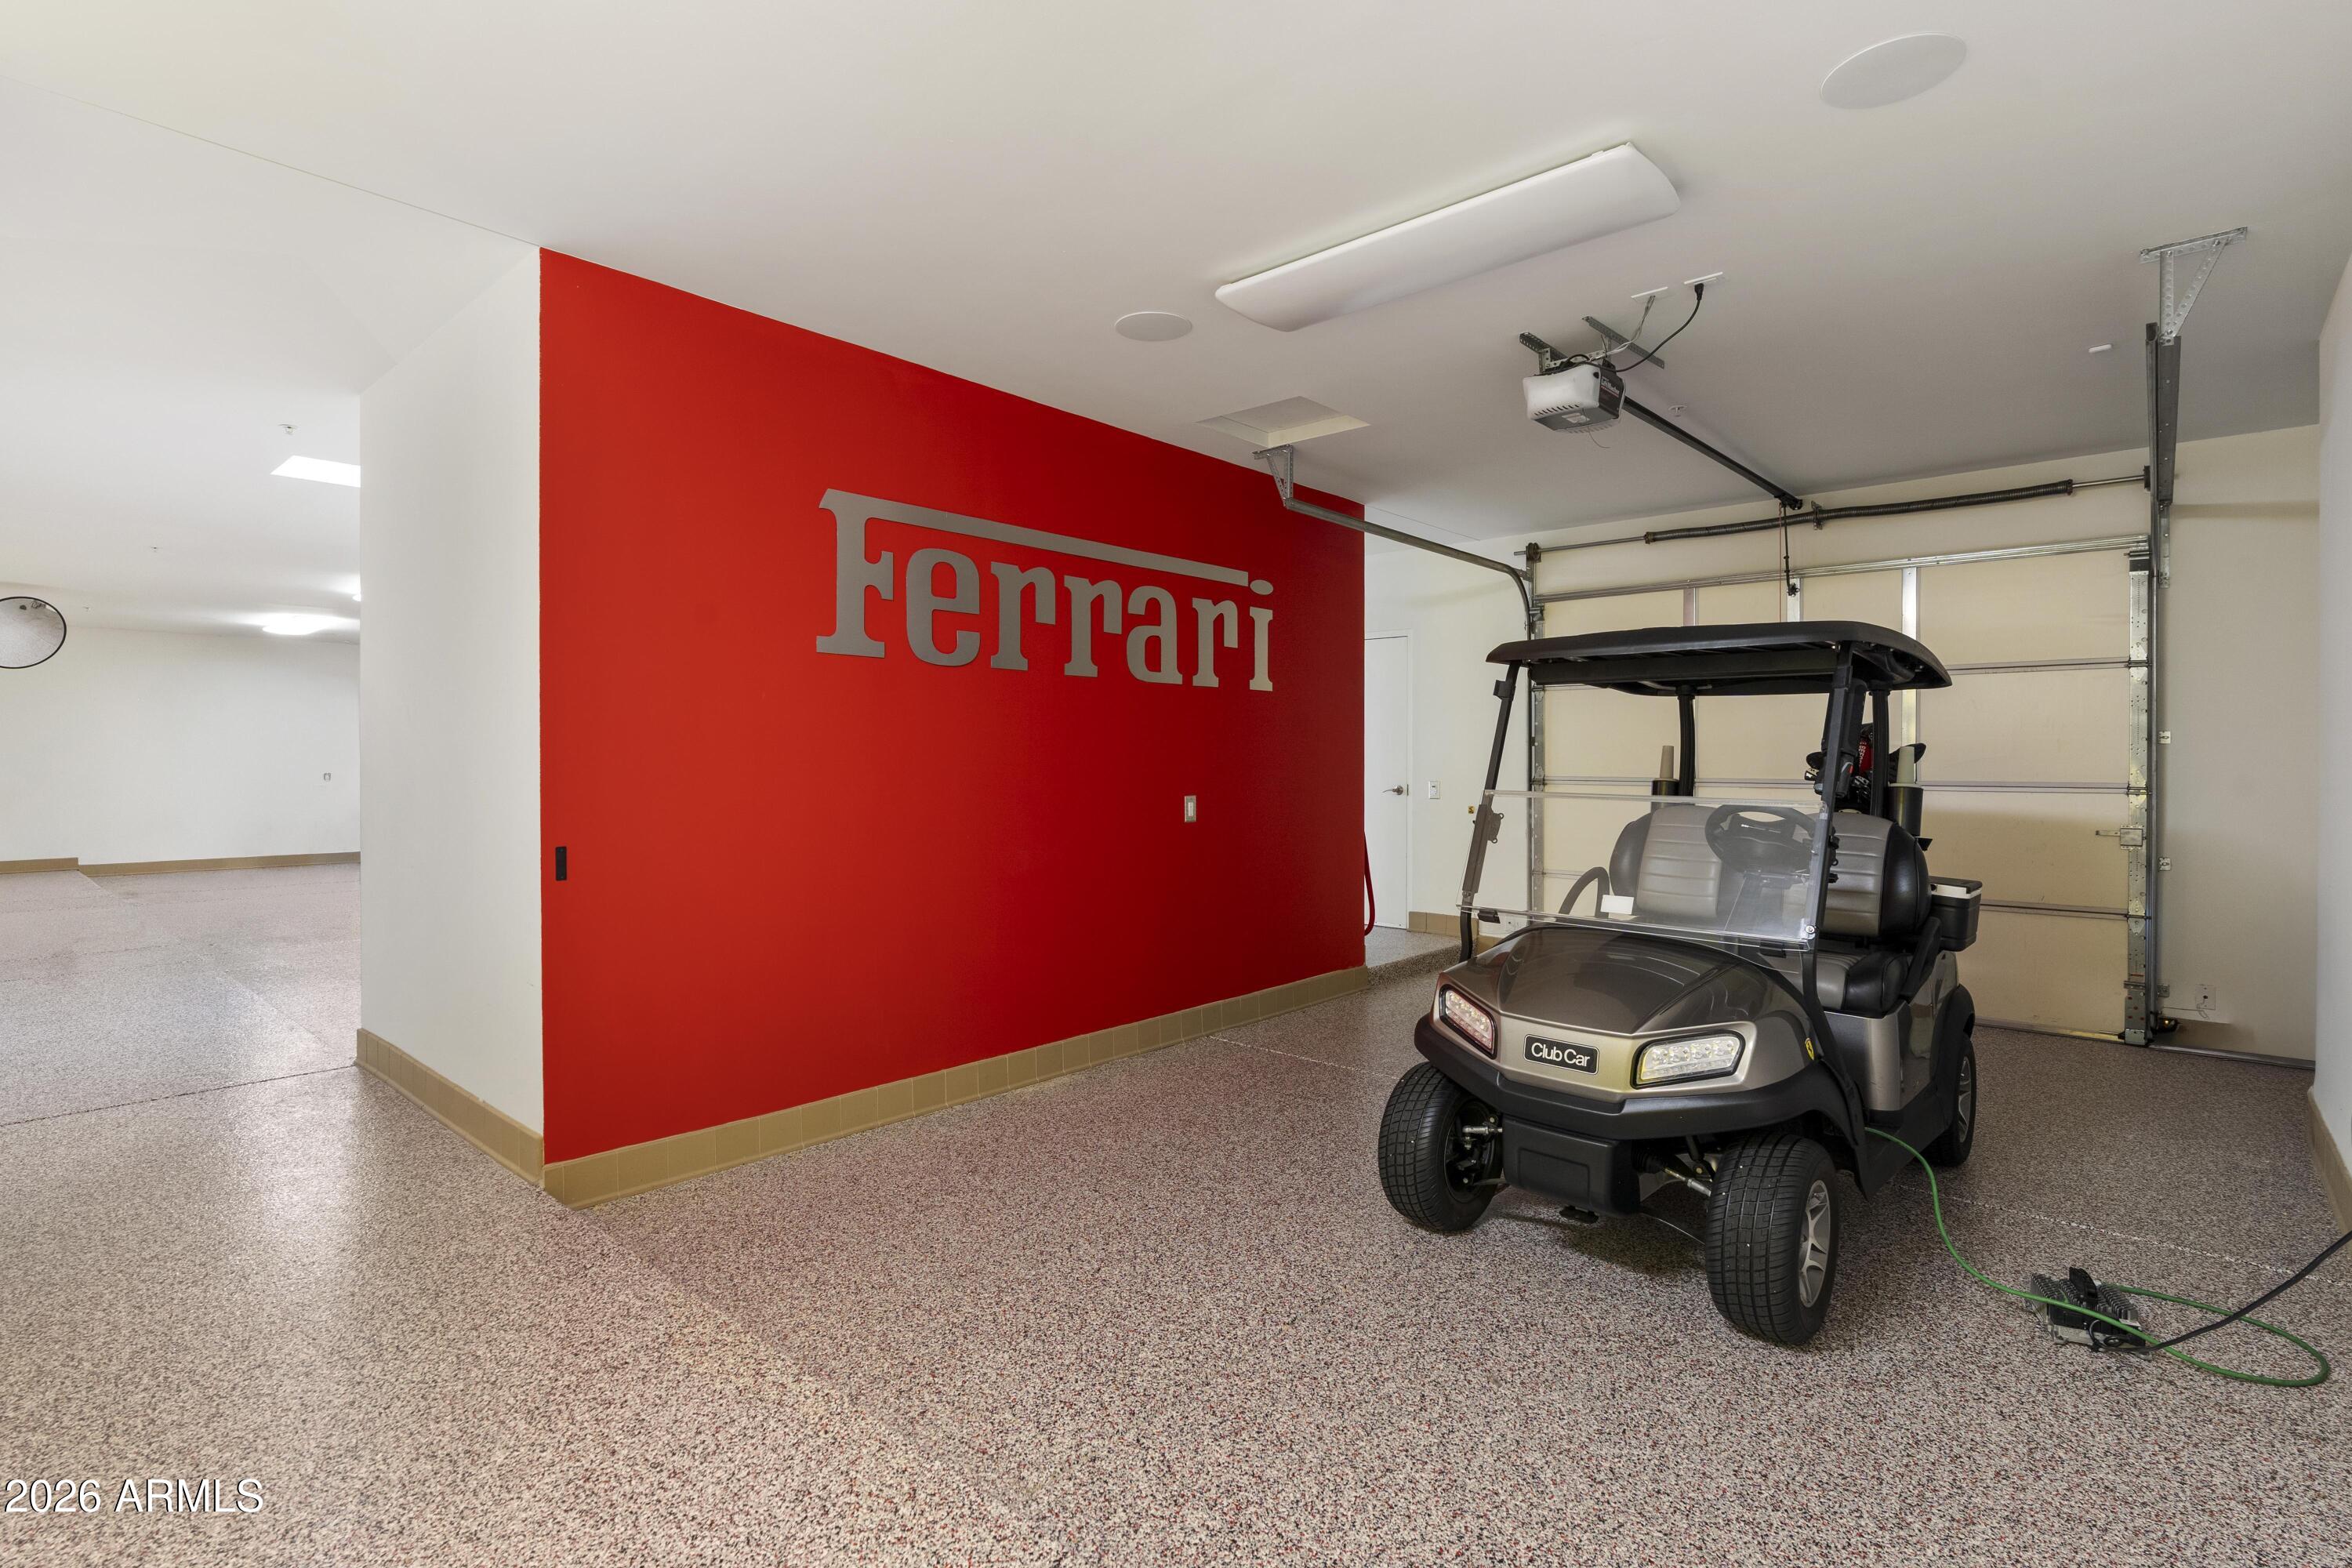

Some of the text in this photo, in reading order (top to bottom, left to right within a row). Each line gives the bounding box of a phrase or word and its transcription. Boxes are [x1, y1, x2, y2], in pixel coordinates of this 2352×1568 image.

[816, 488, 1273, 691] Ferrari
[1531, 1042, 1590, 1067] Club Car
